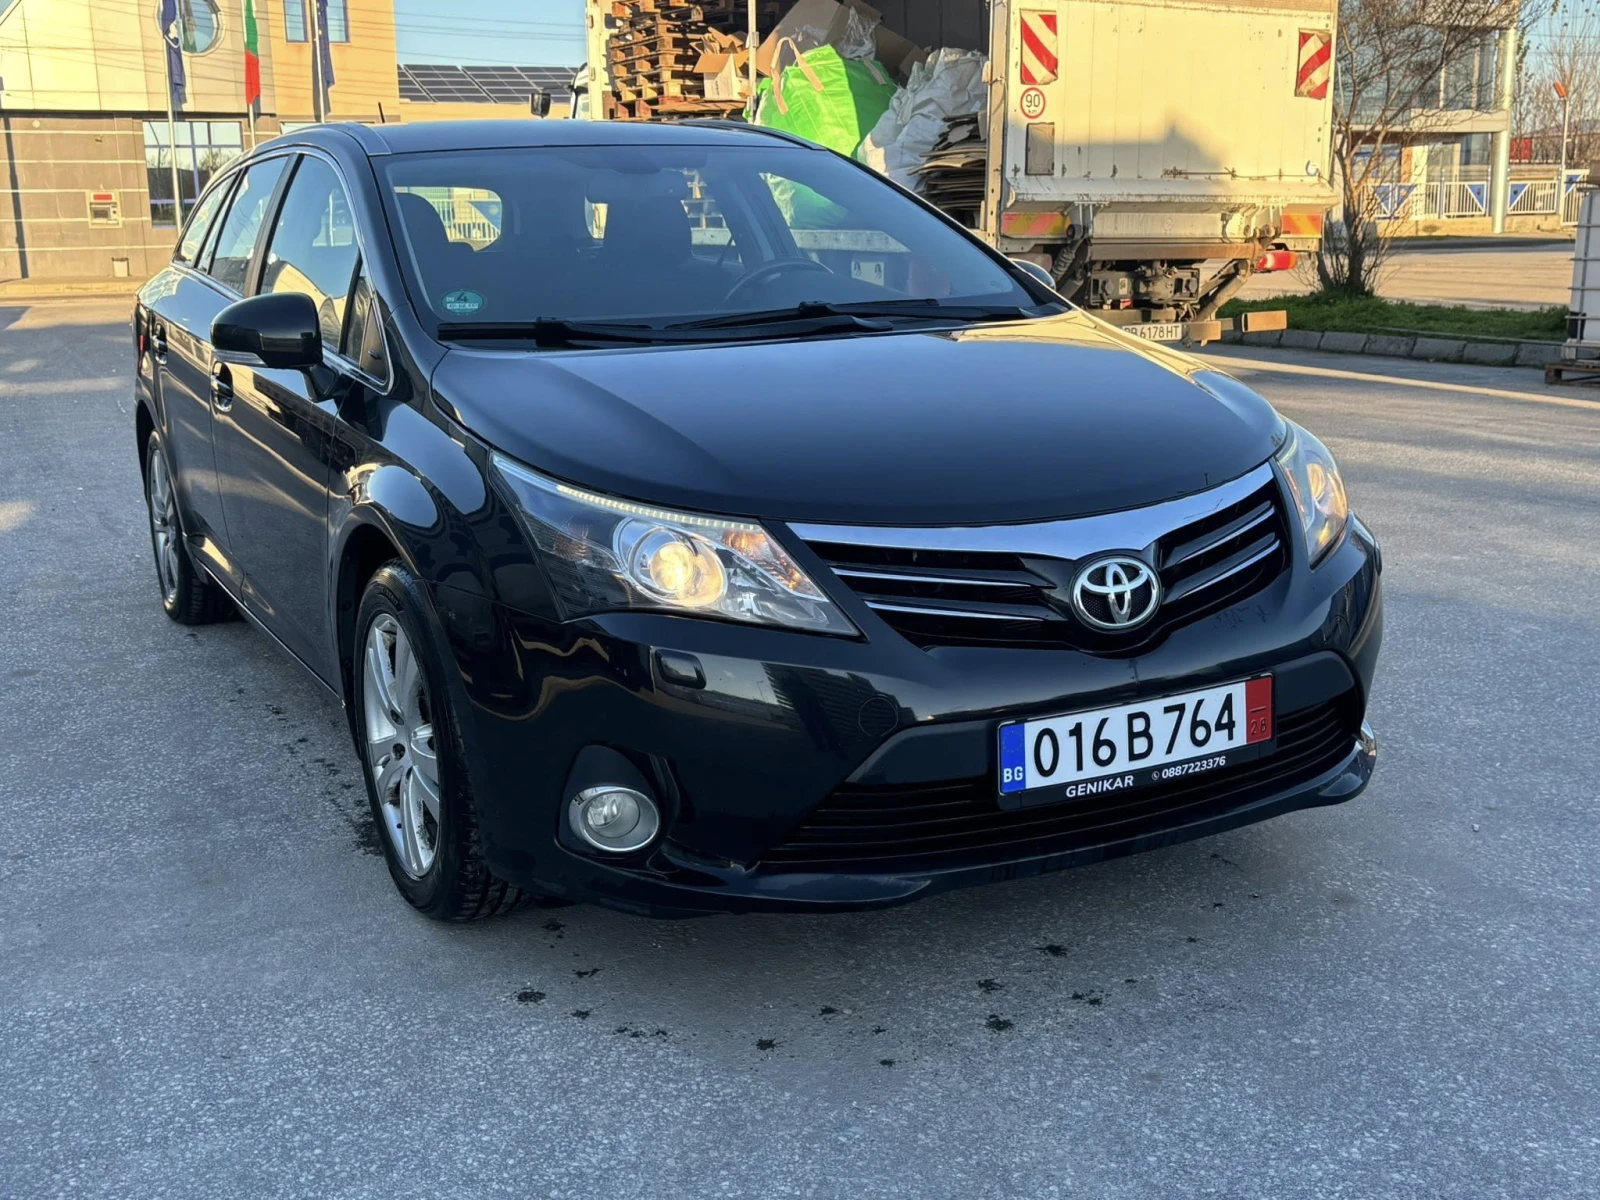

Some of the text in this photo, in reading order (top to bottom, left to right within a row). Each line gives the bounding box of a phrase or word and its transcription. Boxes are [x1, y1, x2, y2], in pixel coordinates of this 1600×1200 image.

[1025, 93, 1041, 107] 90
[456, 292, 468, 303] 4
[1033, 692, 1236, 778] 016B764
[1003, 765, 1024, 783] BG
[1065, 755, 1226, 798] GENIKAR 0887223376
